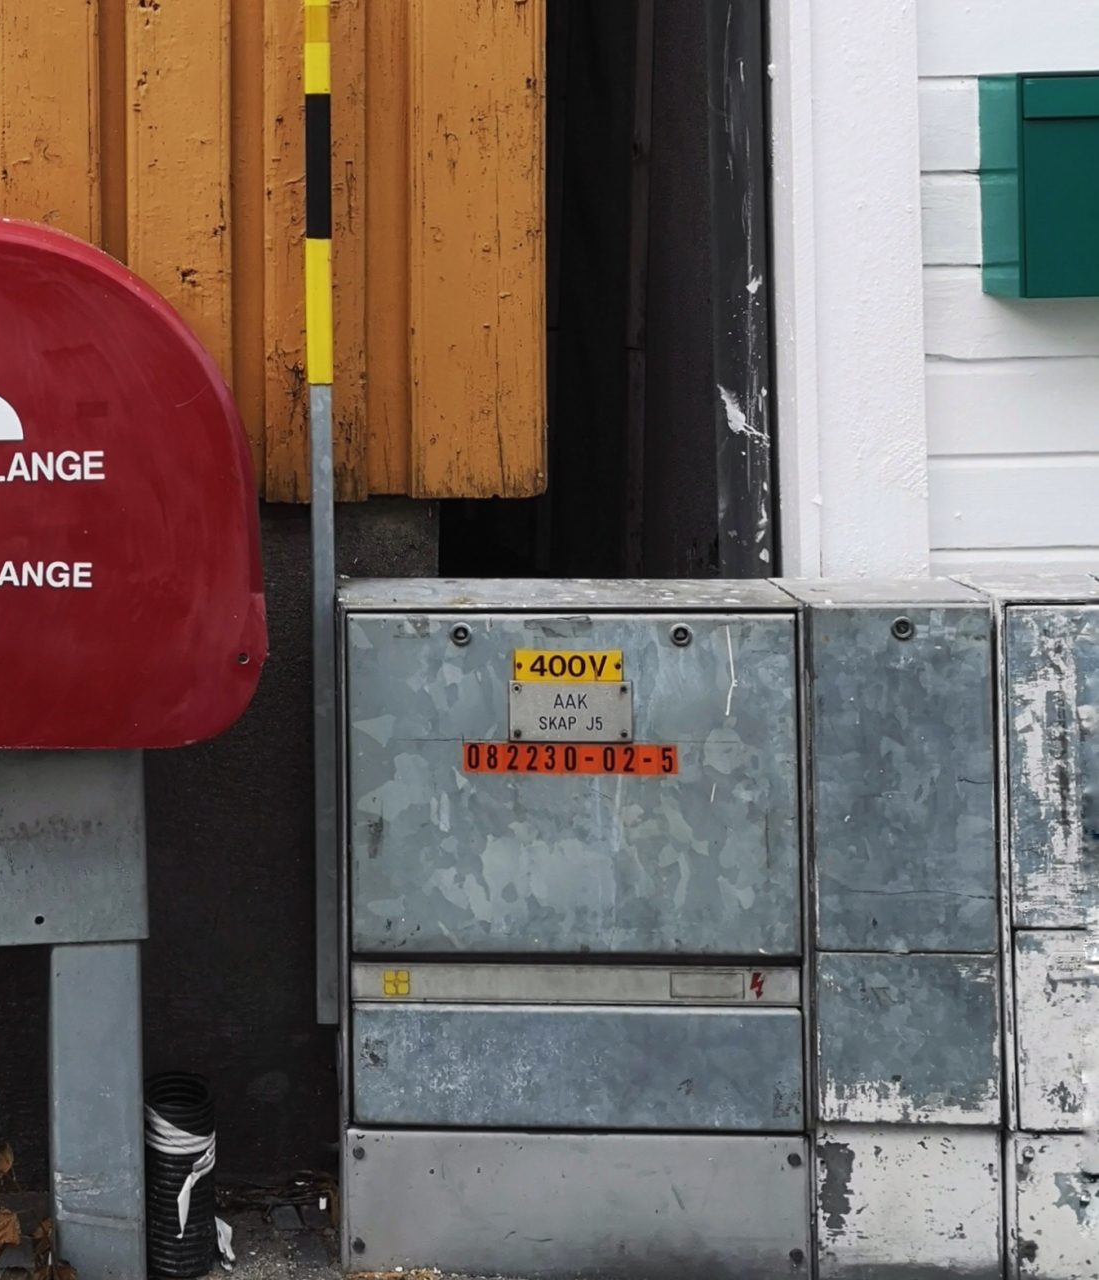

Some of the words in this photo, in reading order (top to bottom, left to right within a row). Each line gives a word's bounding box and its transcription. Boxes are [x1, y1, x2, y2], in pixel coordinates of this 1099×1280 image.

[529, 654, 608, 677] 400V
[553, 693, 588, 710] AAK
[538, 716, 577, 731] SKAP
[586, 716, 603, 731] J5
